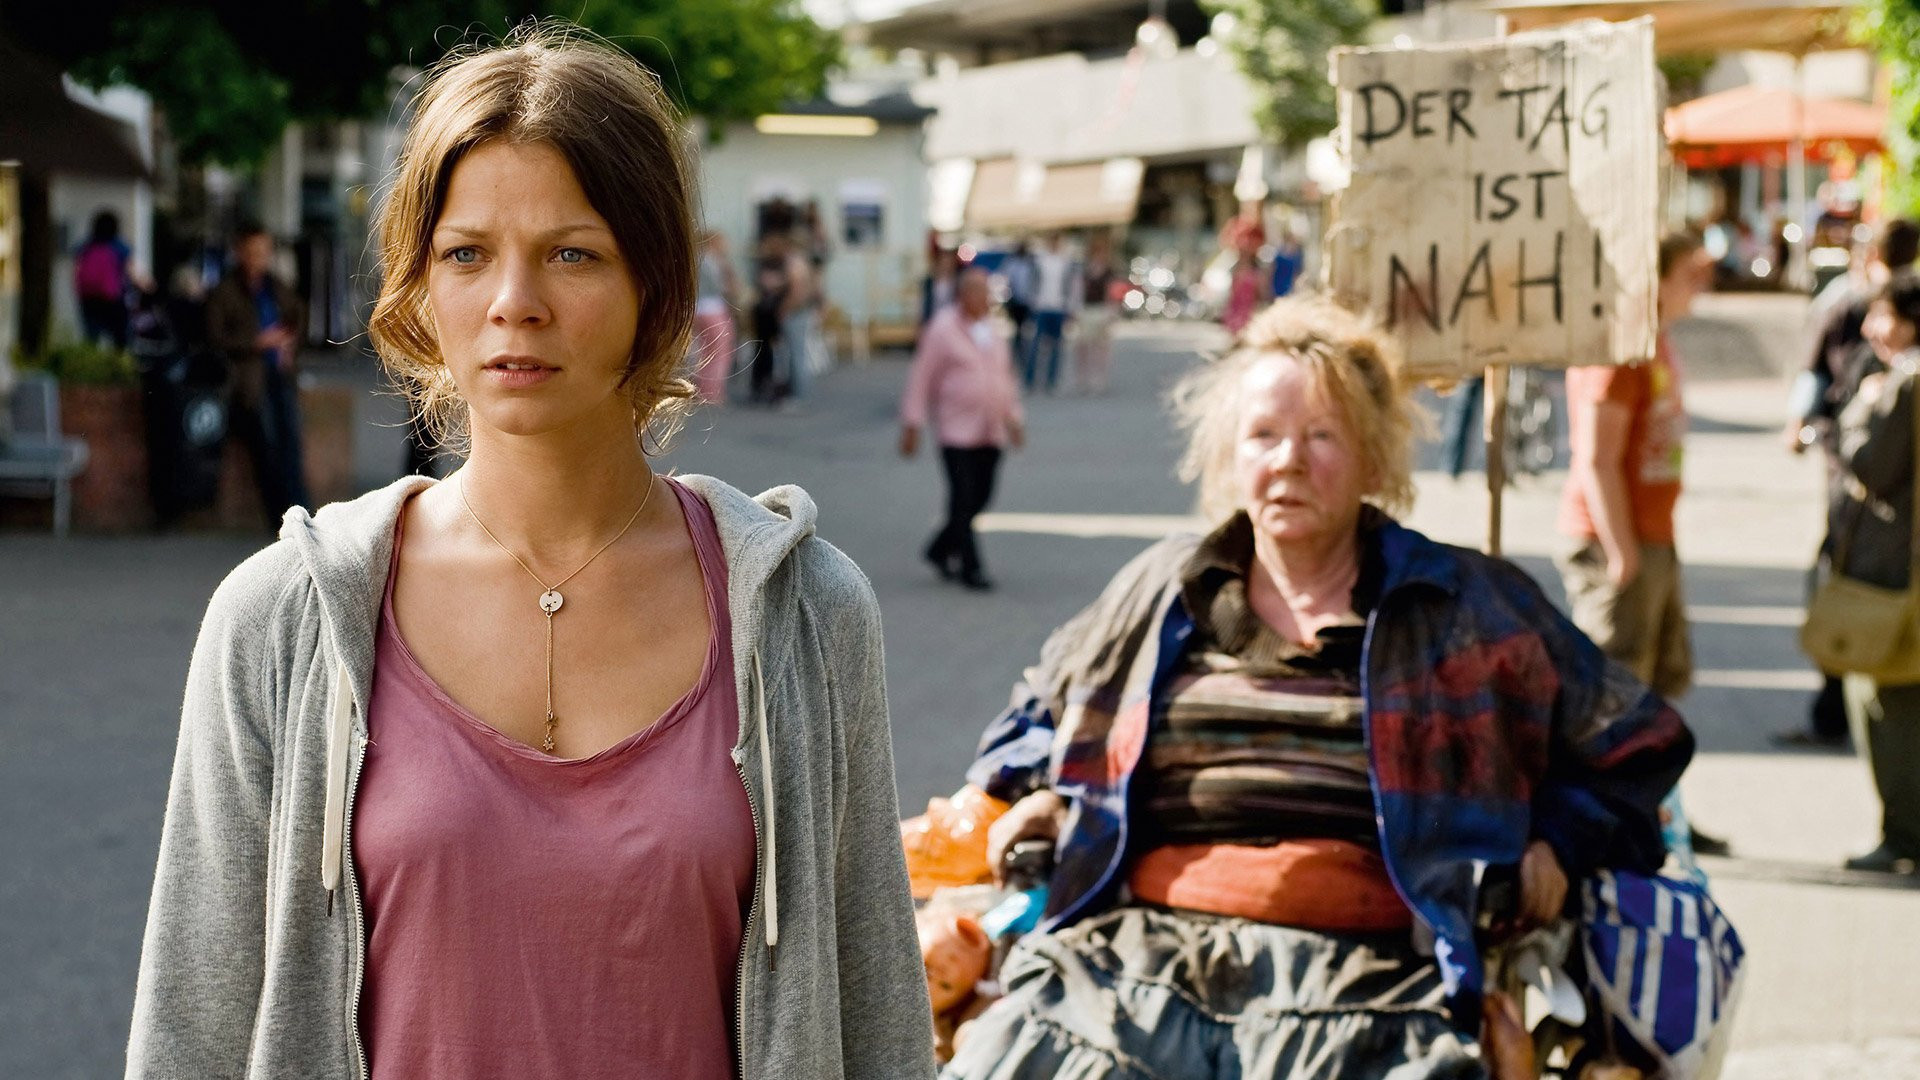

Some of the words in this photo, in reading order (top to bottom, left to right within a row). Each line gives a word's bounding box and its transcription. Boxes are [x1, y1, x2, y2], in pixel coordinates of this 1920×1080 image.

[1357, 81, 1477, 153] DER
[1496, 81, 1611, 153] TAG
[1474, 171, 1563, 222] IST
[1385, 228, 1604, 334] NAH!
